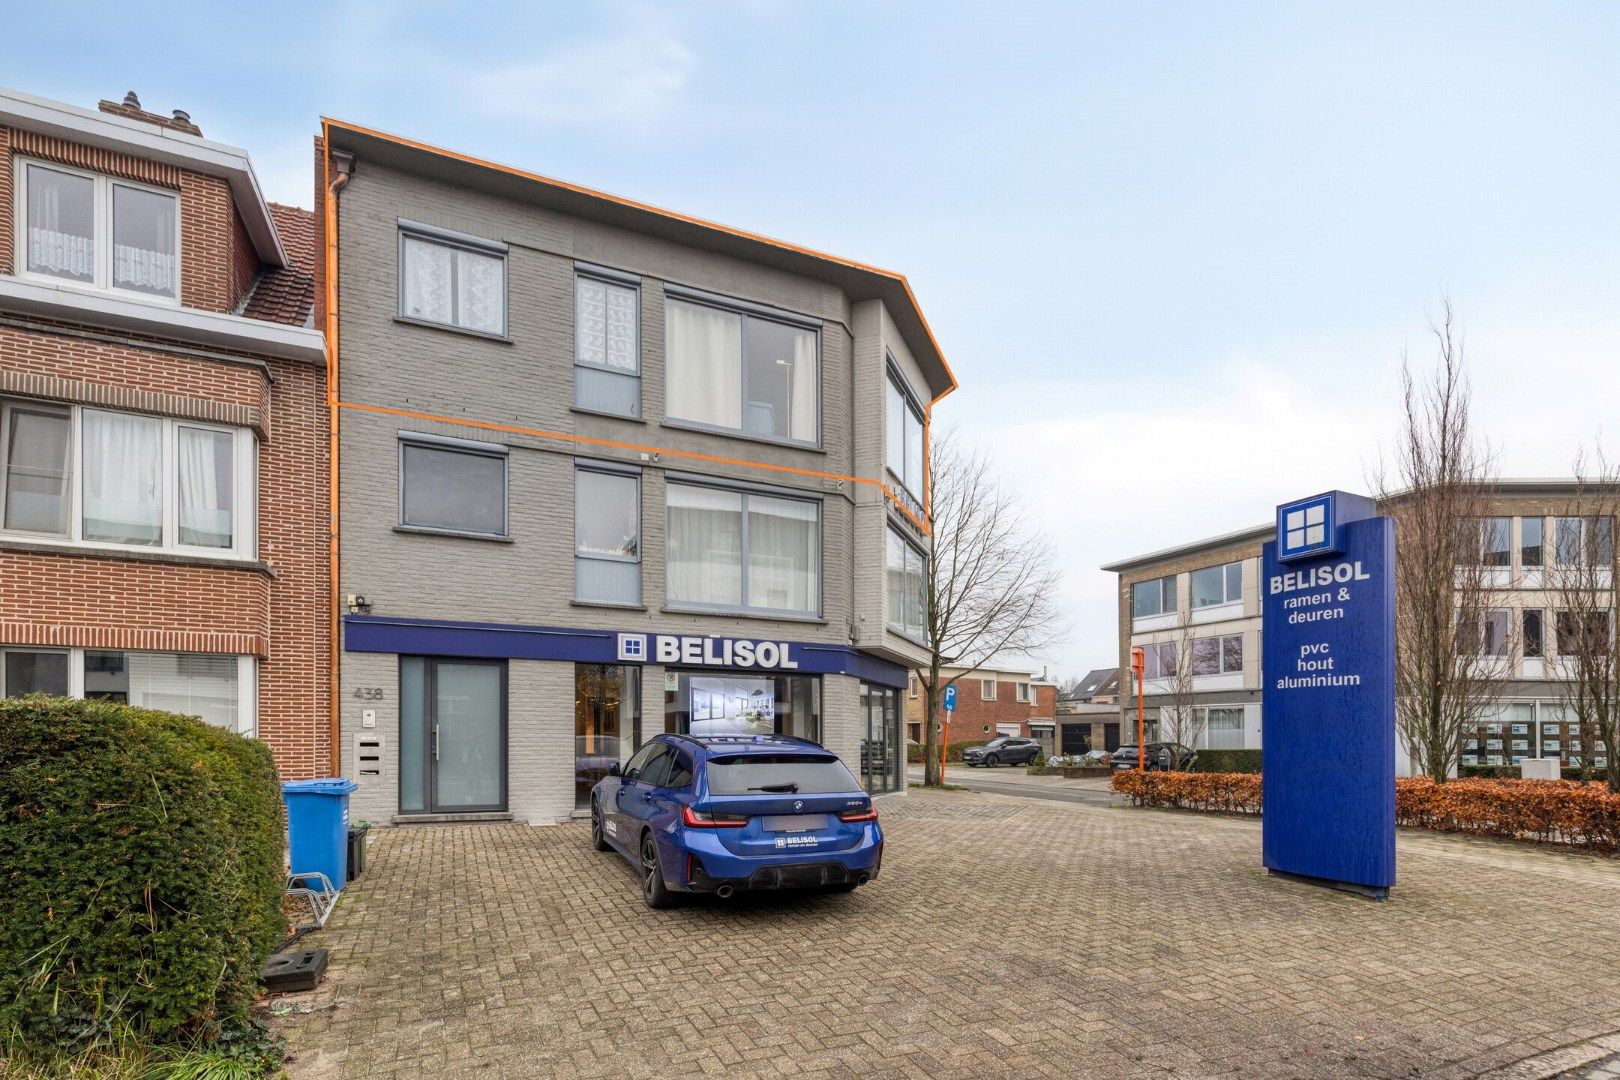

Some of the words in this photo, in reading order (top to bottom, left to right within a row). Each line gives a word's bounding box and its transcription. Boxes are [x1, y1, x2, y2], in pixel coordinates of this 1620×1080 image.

[1270, 561, 1370, 595] BELISOL
[1284, 592, 1331, 609] ramen
[1337, 587, 1350, 601] &
[1288, 608, 1344, 624] deuren
[656, 635, 798, 669] BELISOL
[1301, 643, 1329, 658] pvc
[1297, 657, 1333, 671] hout
[1277, 673, 1360, 689] aluminium
[354, 688, 383, 700] 438
[946, 687, 955, 700] P
[787, 836, 818, 844] BELISOL
